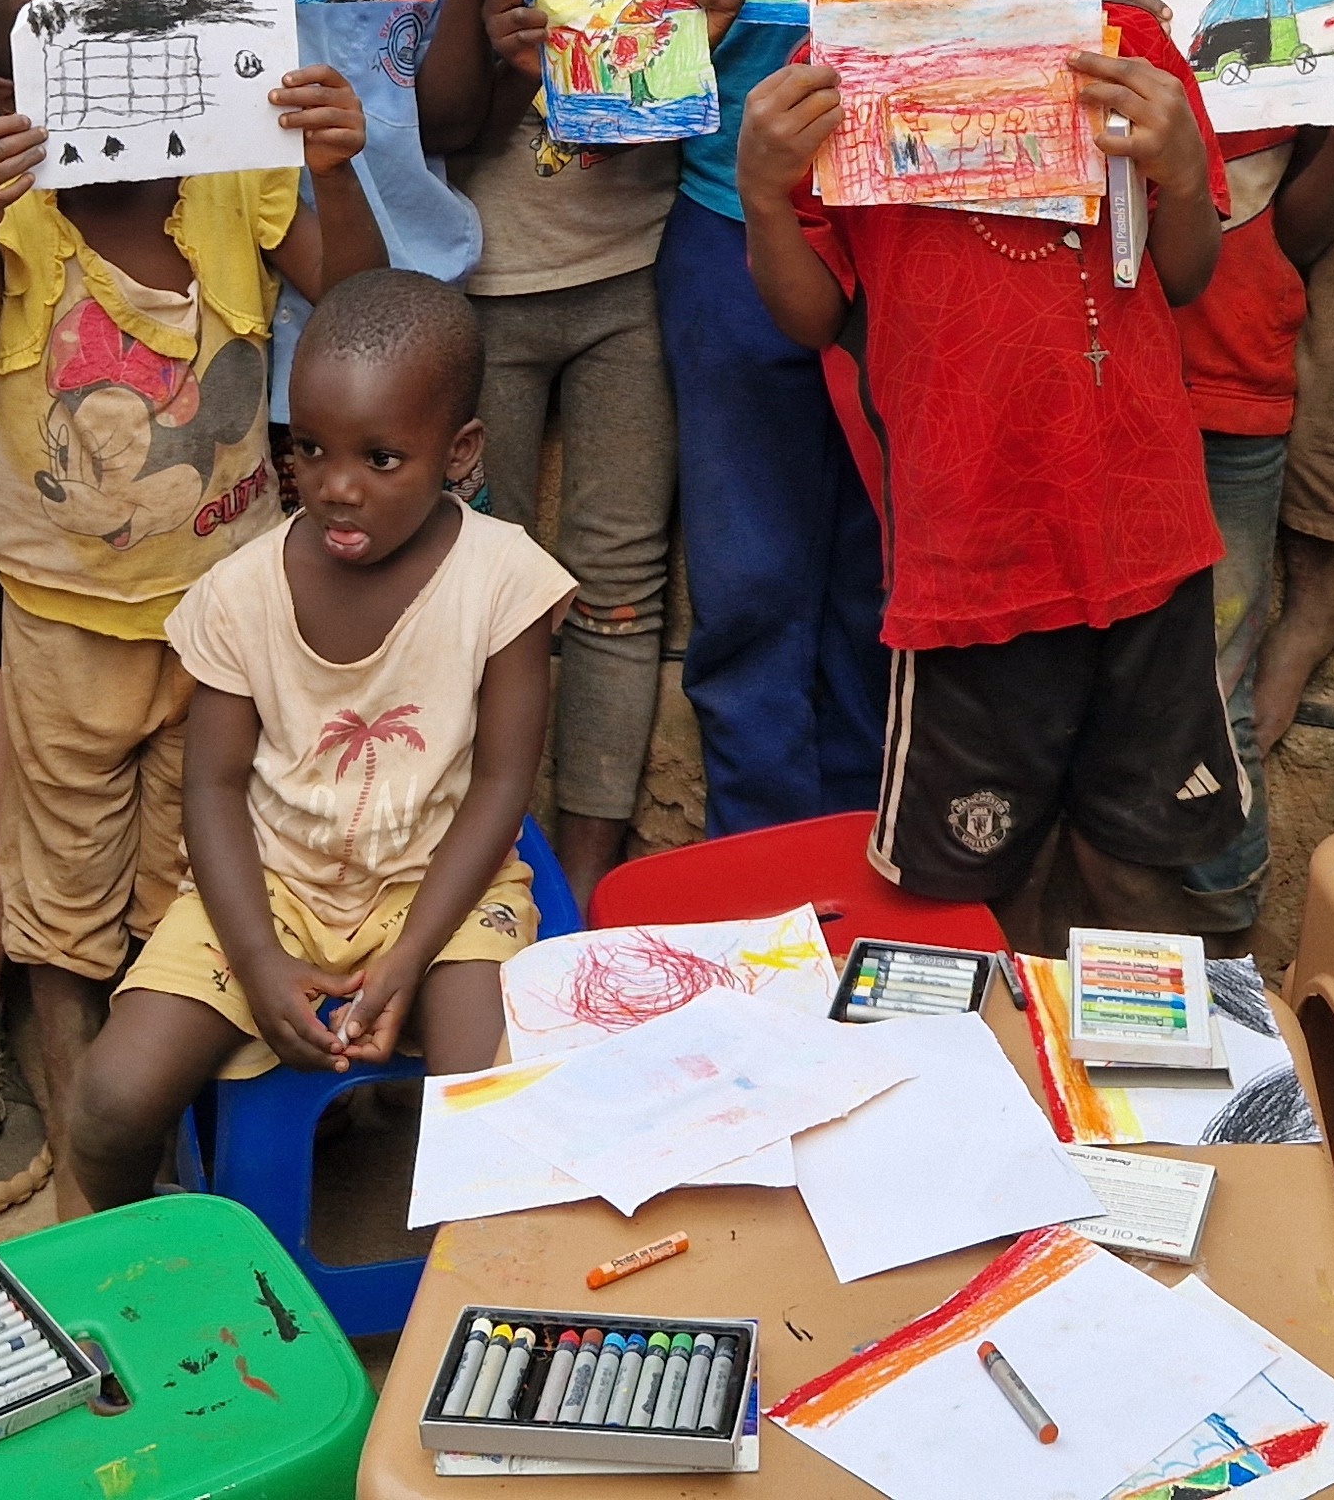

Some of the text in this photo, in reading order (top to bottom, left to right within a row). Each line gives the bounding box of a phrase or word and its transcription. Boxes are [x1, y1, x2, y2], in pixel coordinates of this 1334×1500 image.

[1116, 241, 1127, 254] Oil
[1067, 1221, 1108, 1236] Paste
[1111, 1228, 1134, 1240] Oil
